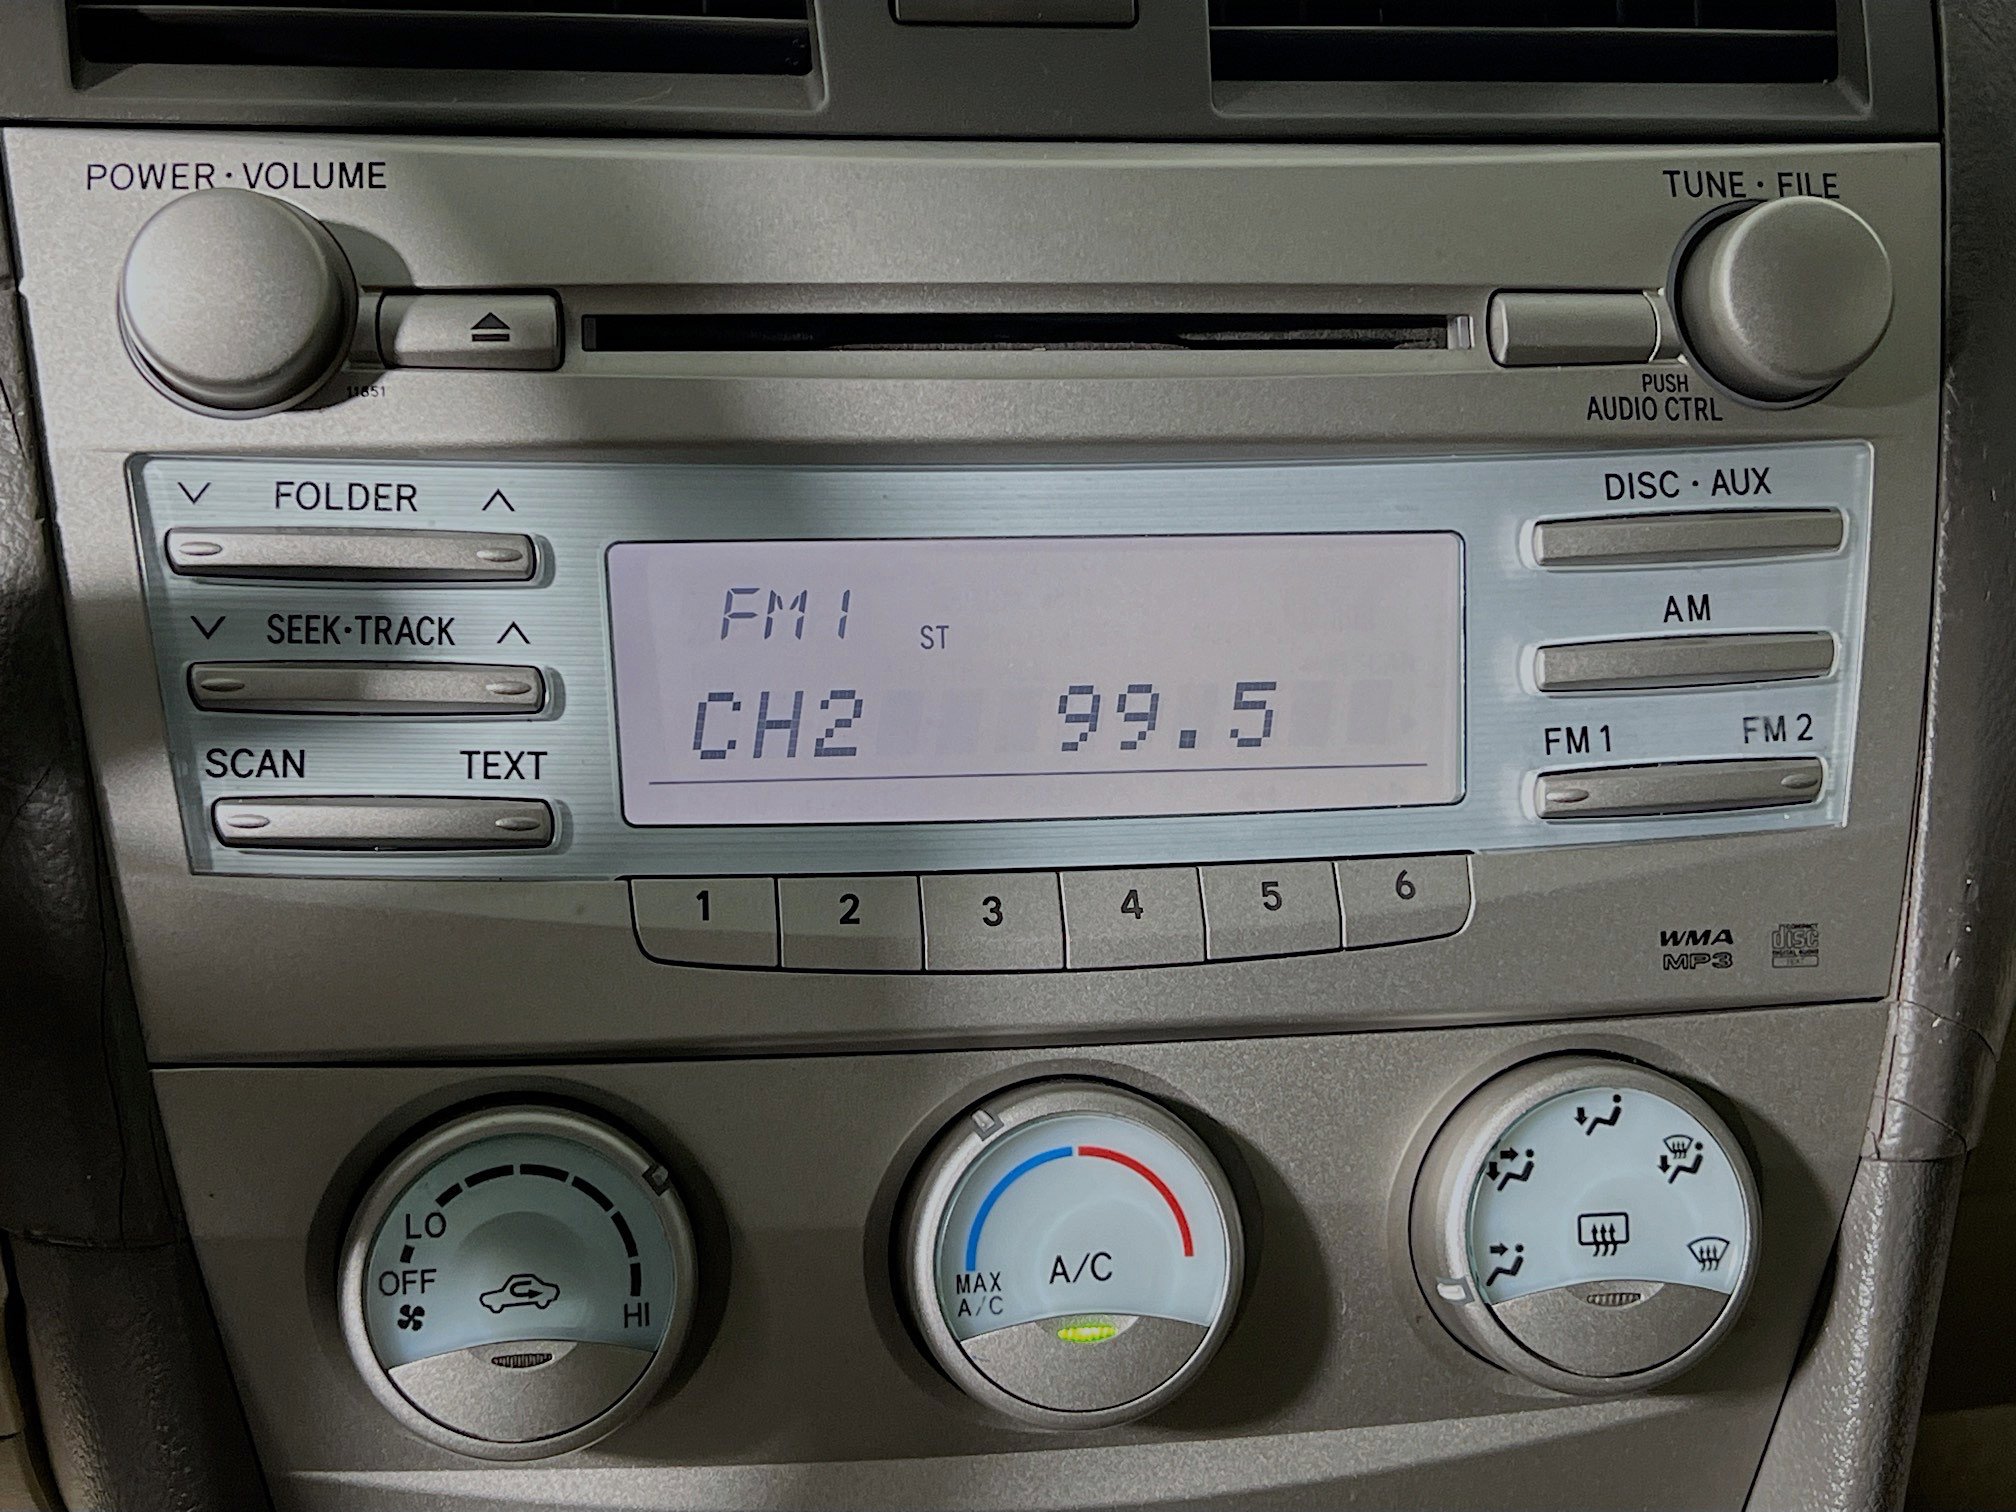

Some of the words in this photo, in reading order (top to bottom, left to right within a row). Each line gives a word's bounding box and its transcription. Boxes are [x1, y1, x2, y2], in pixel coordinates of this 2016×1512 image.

[86, 162, 216, 190] POWER
[242, 161, 388, 189] VOLUME
[1662, 170, 1747, 198] TUNE
[1777, 171, 1841, 199] FILE
[1641, 373, 1689, 393] PUSH
[1586, 397, 1658, 421] AUDIO
[1664, 396, 1724, 421] CTRL
[275, 480, 418, 512] FOLDER
[1604, 469, 1681, 501] DISC
[1710, 466, 1772, 497] AUX
[719, 586, 852, 641] FM1
[1662, 593, 1712, 624] AM
[919, 624, 951, 651] ST
[691, 688, 865, 761] CH2
[1056, 680, 1279, 753] 99.5
[204, 747, 307, 779] SCAN
[459, 750, 549, 781] TEXT
[1260, 879, 1285, 912] 5
[1394, 868, 1417, 901] 6
[695, 889, 711, 922] 1
[838, 892, 862, 926] 2
[981, 895, 1005, 928] 3
[1119, 887, 1145, 920] 4
[1660, 929, 1734, 947] WMA
[1663, 952, 1733, 971] MP3
[404, 1211, 447, 1240] LO
[378, 1268, 438, 1297] OFF
[955, 1271, 1002, 1295] MAX
[1049, 1251, 1114, 1285] A/C
[623, 1301, 651, 1329] HI
[957, 1296, 1004, 1318] A/C
